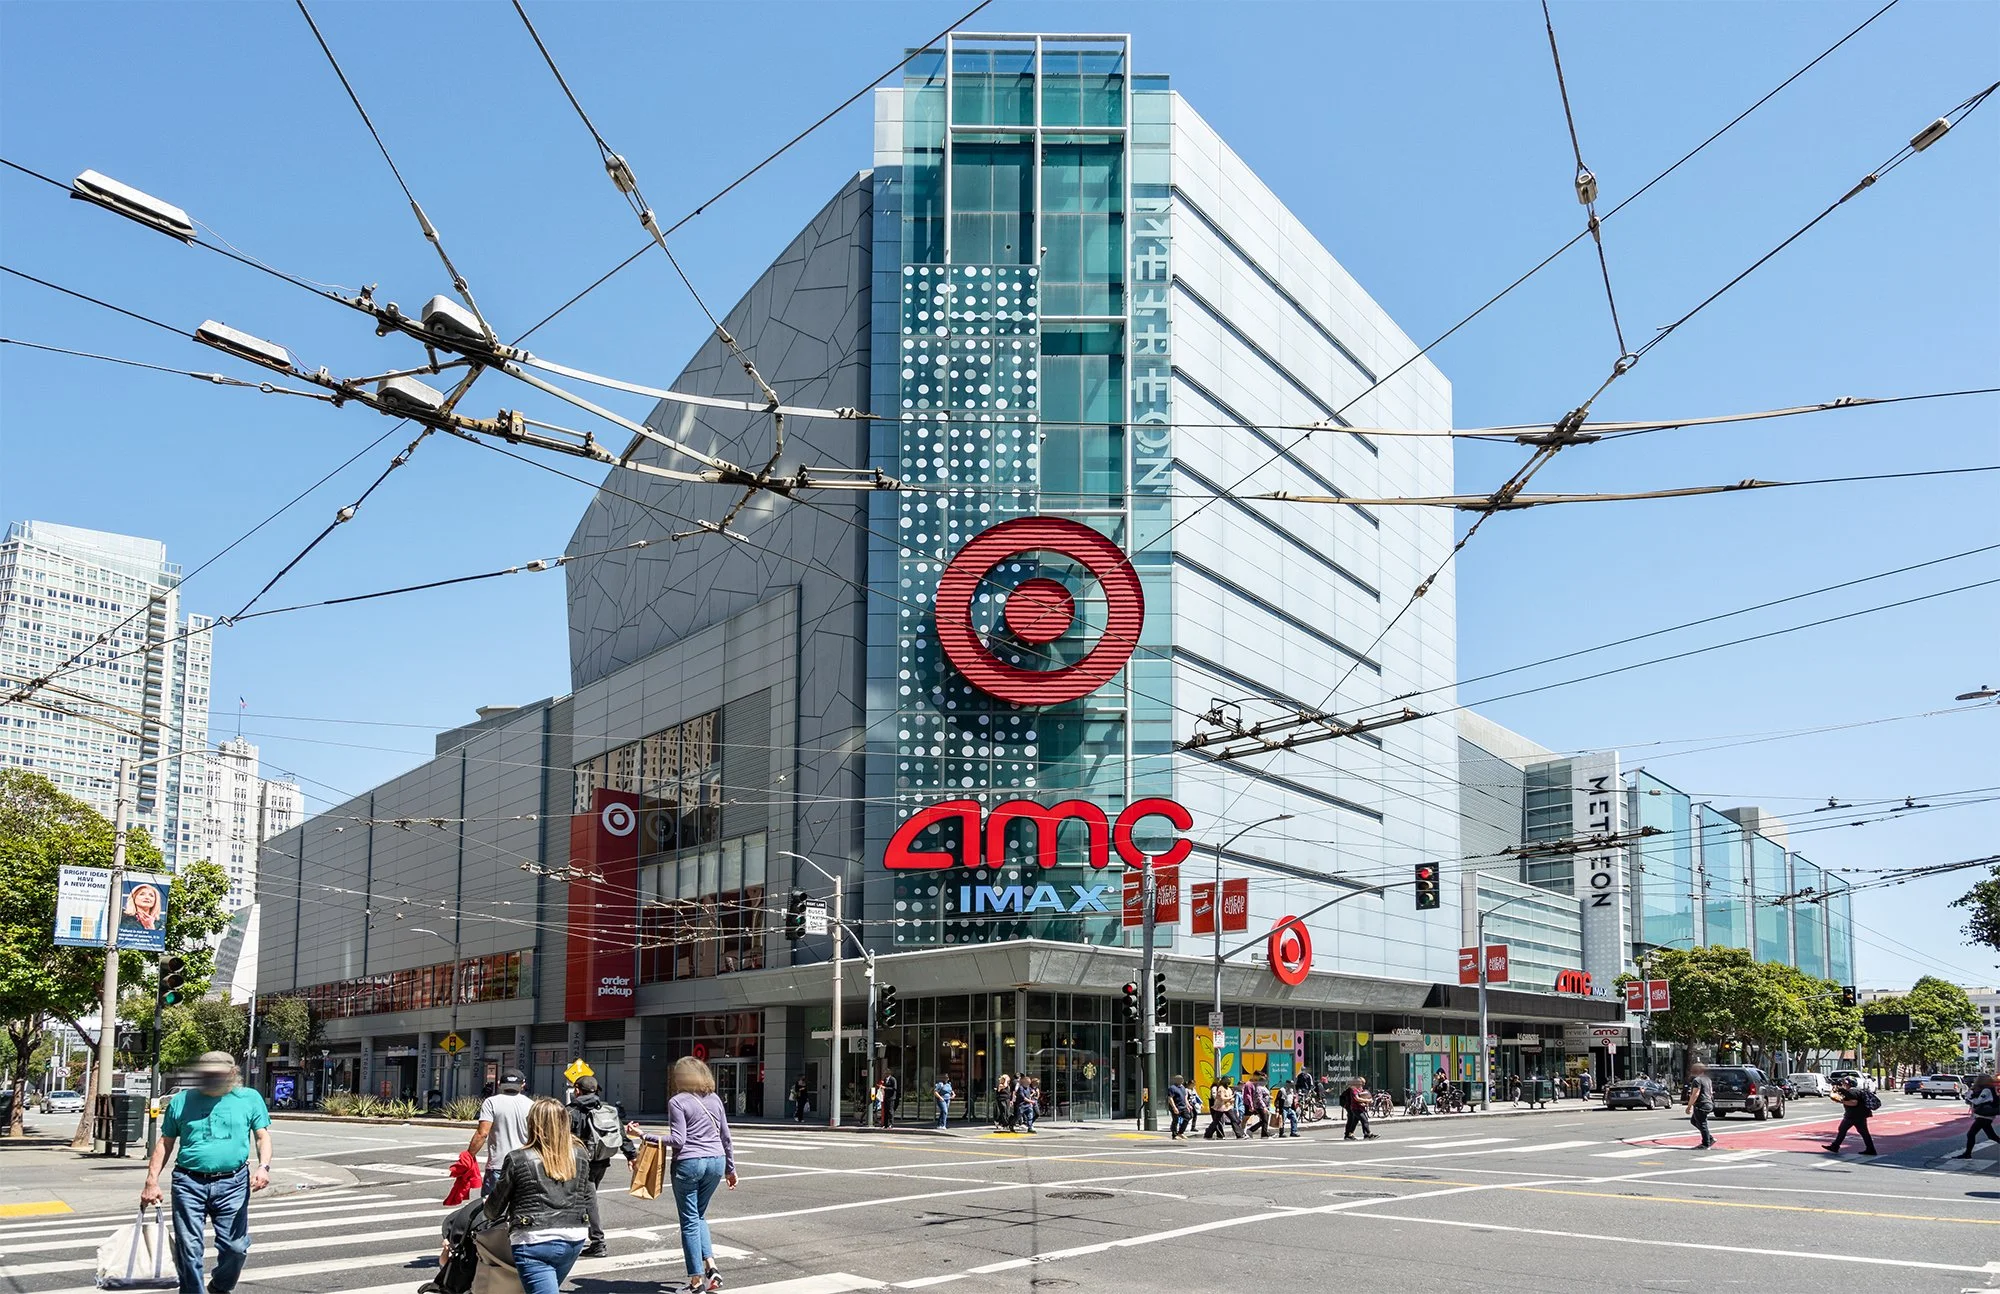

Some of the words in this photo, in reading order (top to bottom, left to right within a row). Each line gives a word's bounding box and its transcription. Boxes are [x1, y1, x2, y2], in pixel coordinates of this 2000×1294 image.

[1136, 197, 1172, 487] METREON
[1589, 776, 1611, 907] METEON
[960, 885, 1110, 913] IMAX
[1157, 894, 1177, 905] CURVE
[1224, 895, 1245, 906] AHEAD
[1224, 904, 1245, 914] CURVE
[601, 976, 630, 985] order
[1556, 969, 1592, 996] amc
[1593, 987, 1608, 997] IMAX
[598, 986, 632, 997] pickup
